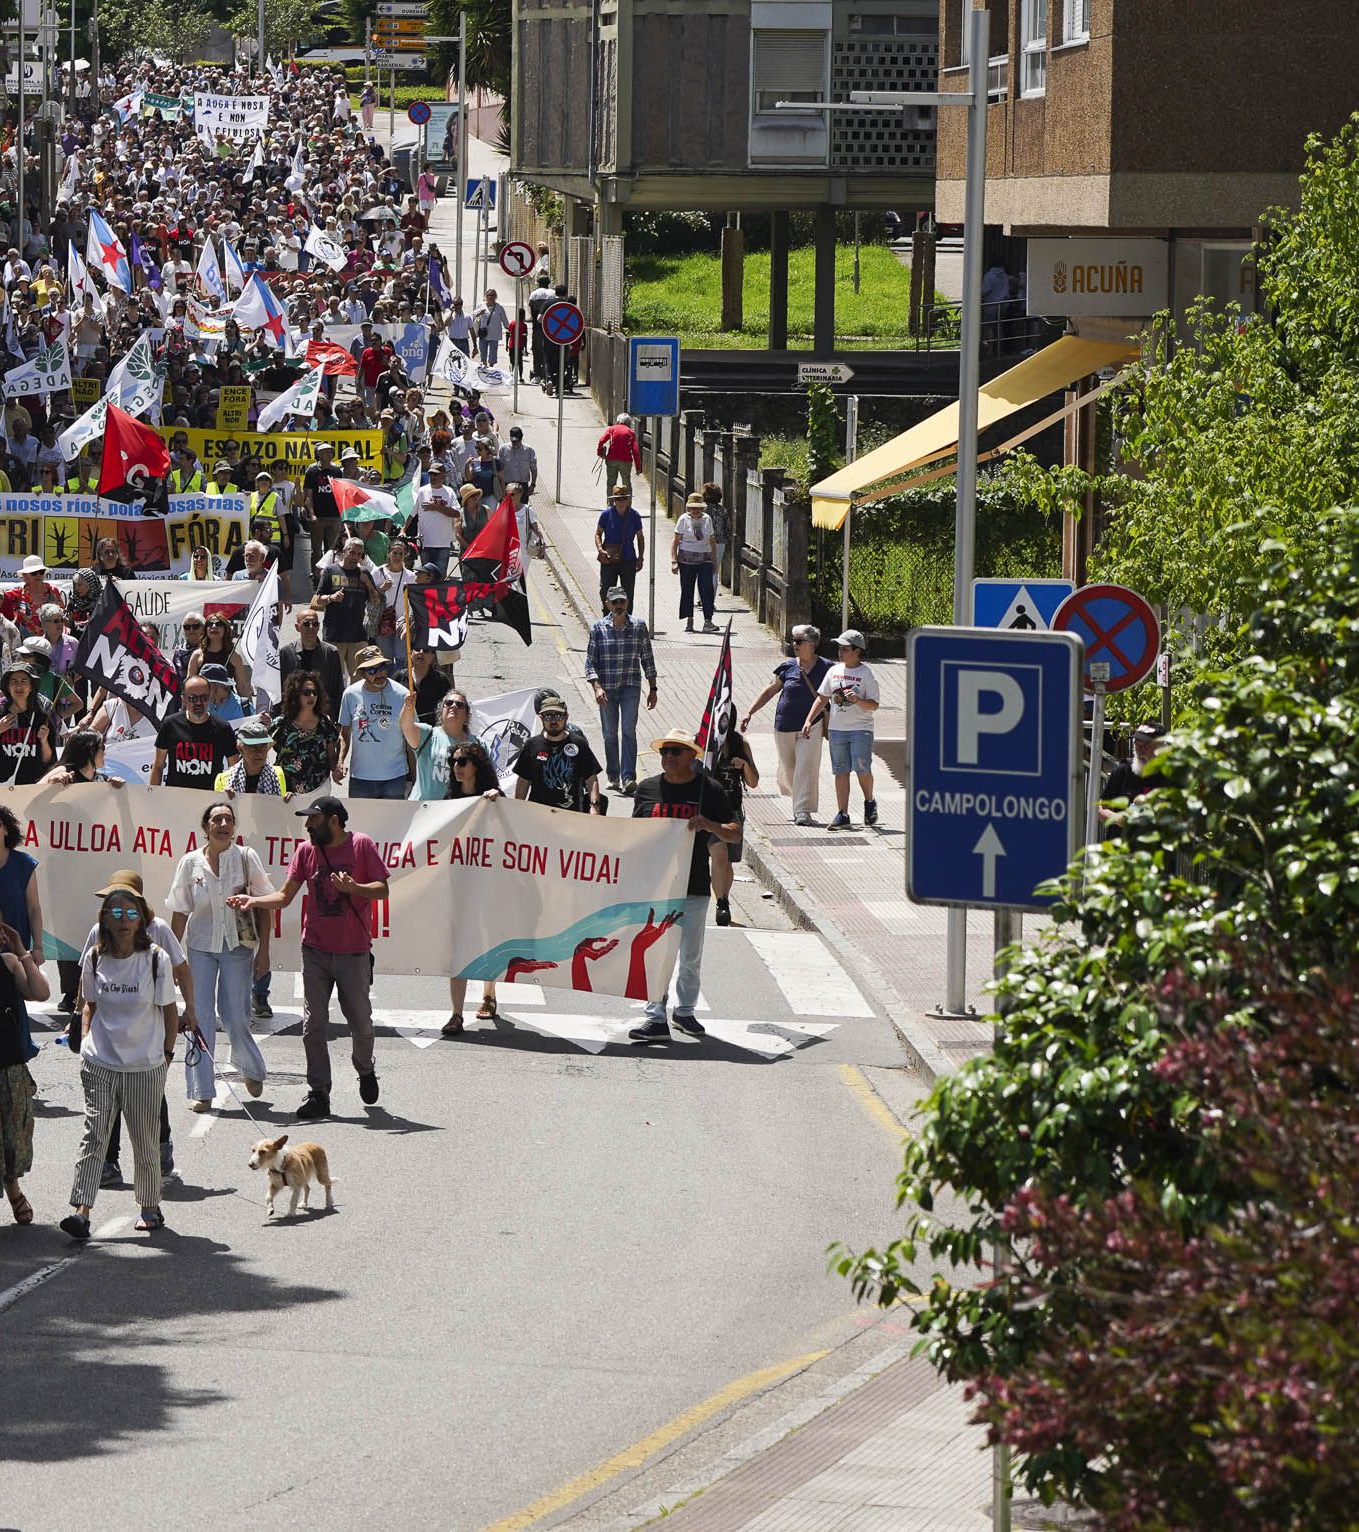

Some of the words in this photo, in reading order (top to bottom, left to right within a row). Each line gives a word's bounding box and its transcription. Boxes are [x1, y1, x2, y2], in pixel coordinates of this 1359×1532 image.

[242, 101, 264, 111] NOSA
[230, 113, 246, 123] NON
[1072, 259, 1143, 294] ACUÑA
[402, 345, 424, 359] bng
[802, 366, 827, 374] CLÍNICA
[224, 388, 247, 396] ENCE
[225, 416, 240, 424] NON
[6, 499, 60, 512] nosos
[108, 501, 144, 517] pola
[168, 499, 206, 514] osas
[169, 513, 243, 556] FÓRA
[124, 588, 172, 617] SAÚDE
[956, 669, 1026, 765] P
[2, 742, 37, 758] NON
[175, 740, 214, 761] ALTRI
[176, 758, 213, 775] NON
[915, 789, 1066, 822] CAMPOLONGO
[49, 819, 121, 853] ULLOA
[133, 825, 174, 858] ATA
[426, 839, 440, 867] E
[449, 837, 495, 869] AIRE
[502, 840, 549, 876] SON
[558, 848, 621, 885] VIDA!
